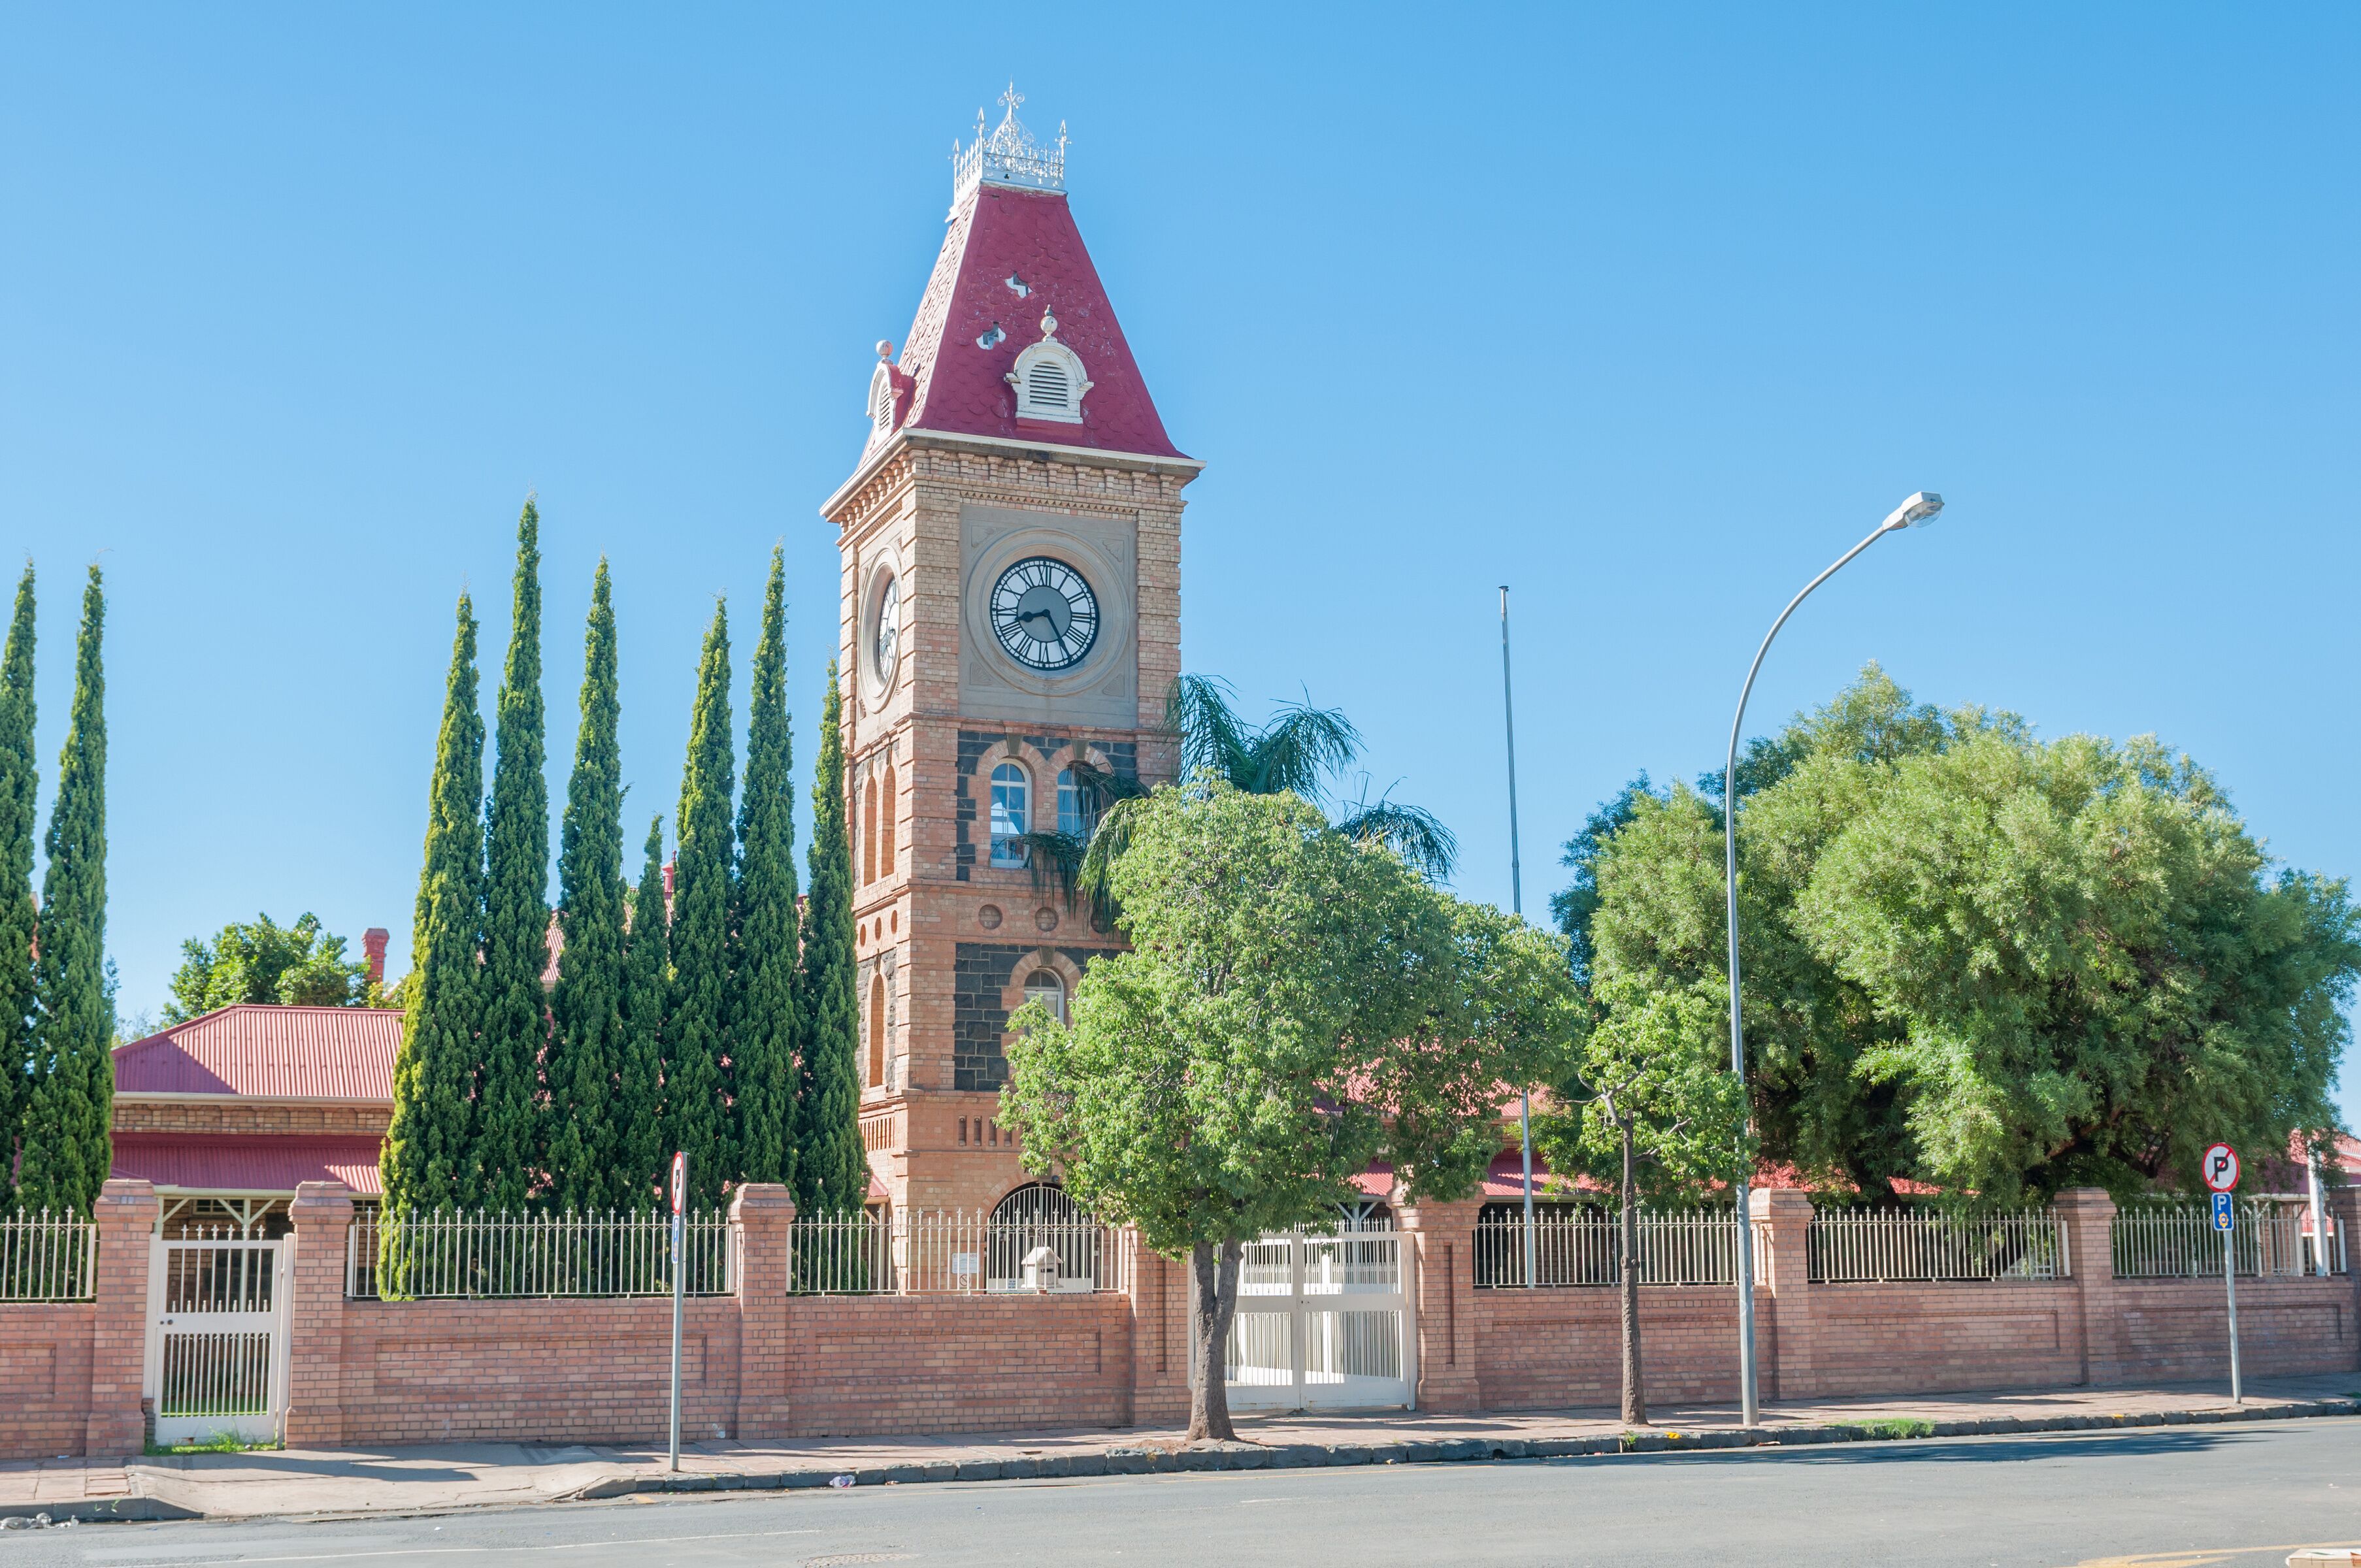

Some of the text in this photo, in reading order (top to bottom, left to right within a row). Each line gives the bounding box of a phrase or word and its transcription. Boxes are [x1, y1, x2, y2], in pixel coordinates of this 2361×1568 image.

[1016, 569, 1034, 590] XI
[1038, 566, 1052, 587] XII
[1058, 572, 1069, 591] I
[1002, 583, 1022, 600] X
[1068, 591, 1085, 604] II
[997, 604, 1017, 616] IX
[1072, 612, 1091, 623] III
[1000, 621, 1022, 641] VIII
[1015, 634, 1033, 658] VII
[1039, 642, 1049, 662] VI
[2214, 1156, 2229, 1182] P
[2217, 1195, 2227, 1211] P
